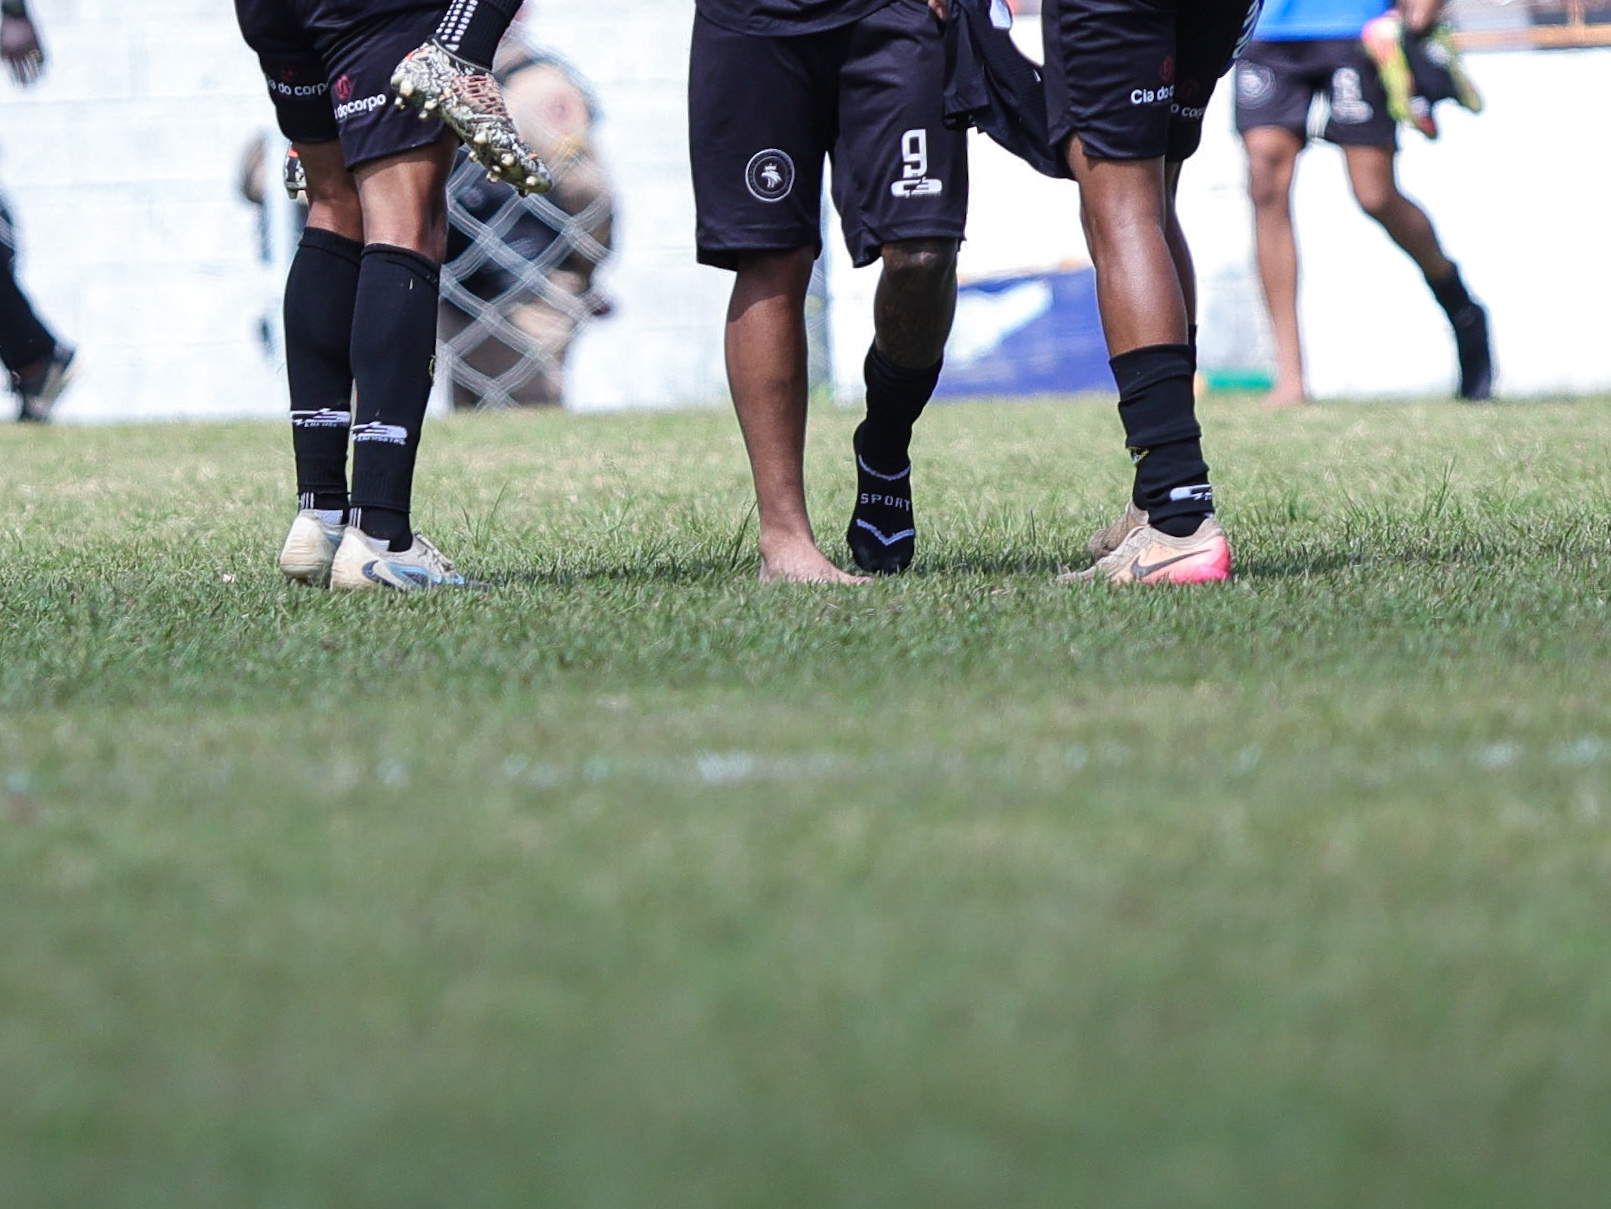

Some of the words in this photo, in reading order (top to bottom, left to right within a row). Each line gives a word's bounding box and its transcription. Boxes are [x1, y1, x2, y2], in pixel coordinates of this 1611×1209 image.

[278, 82, 292, 95] do
[1131, 88, 1155, 104] Cia
[347, 94, 386, 113] corpo
[901, 129, 928, 178] 9
[860, 493, 911, 511] SPORT
